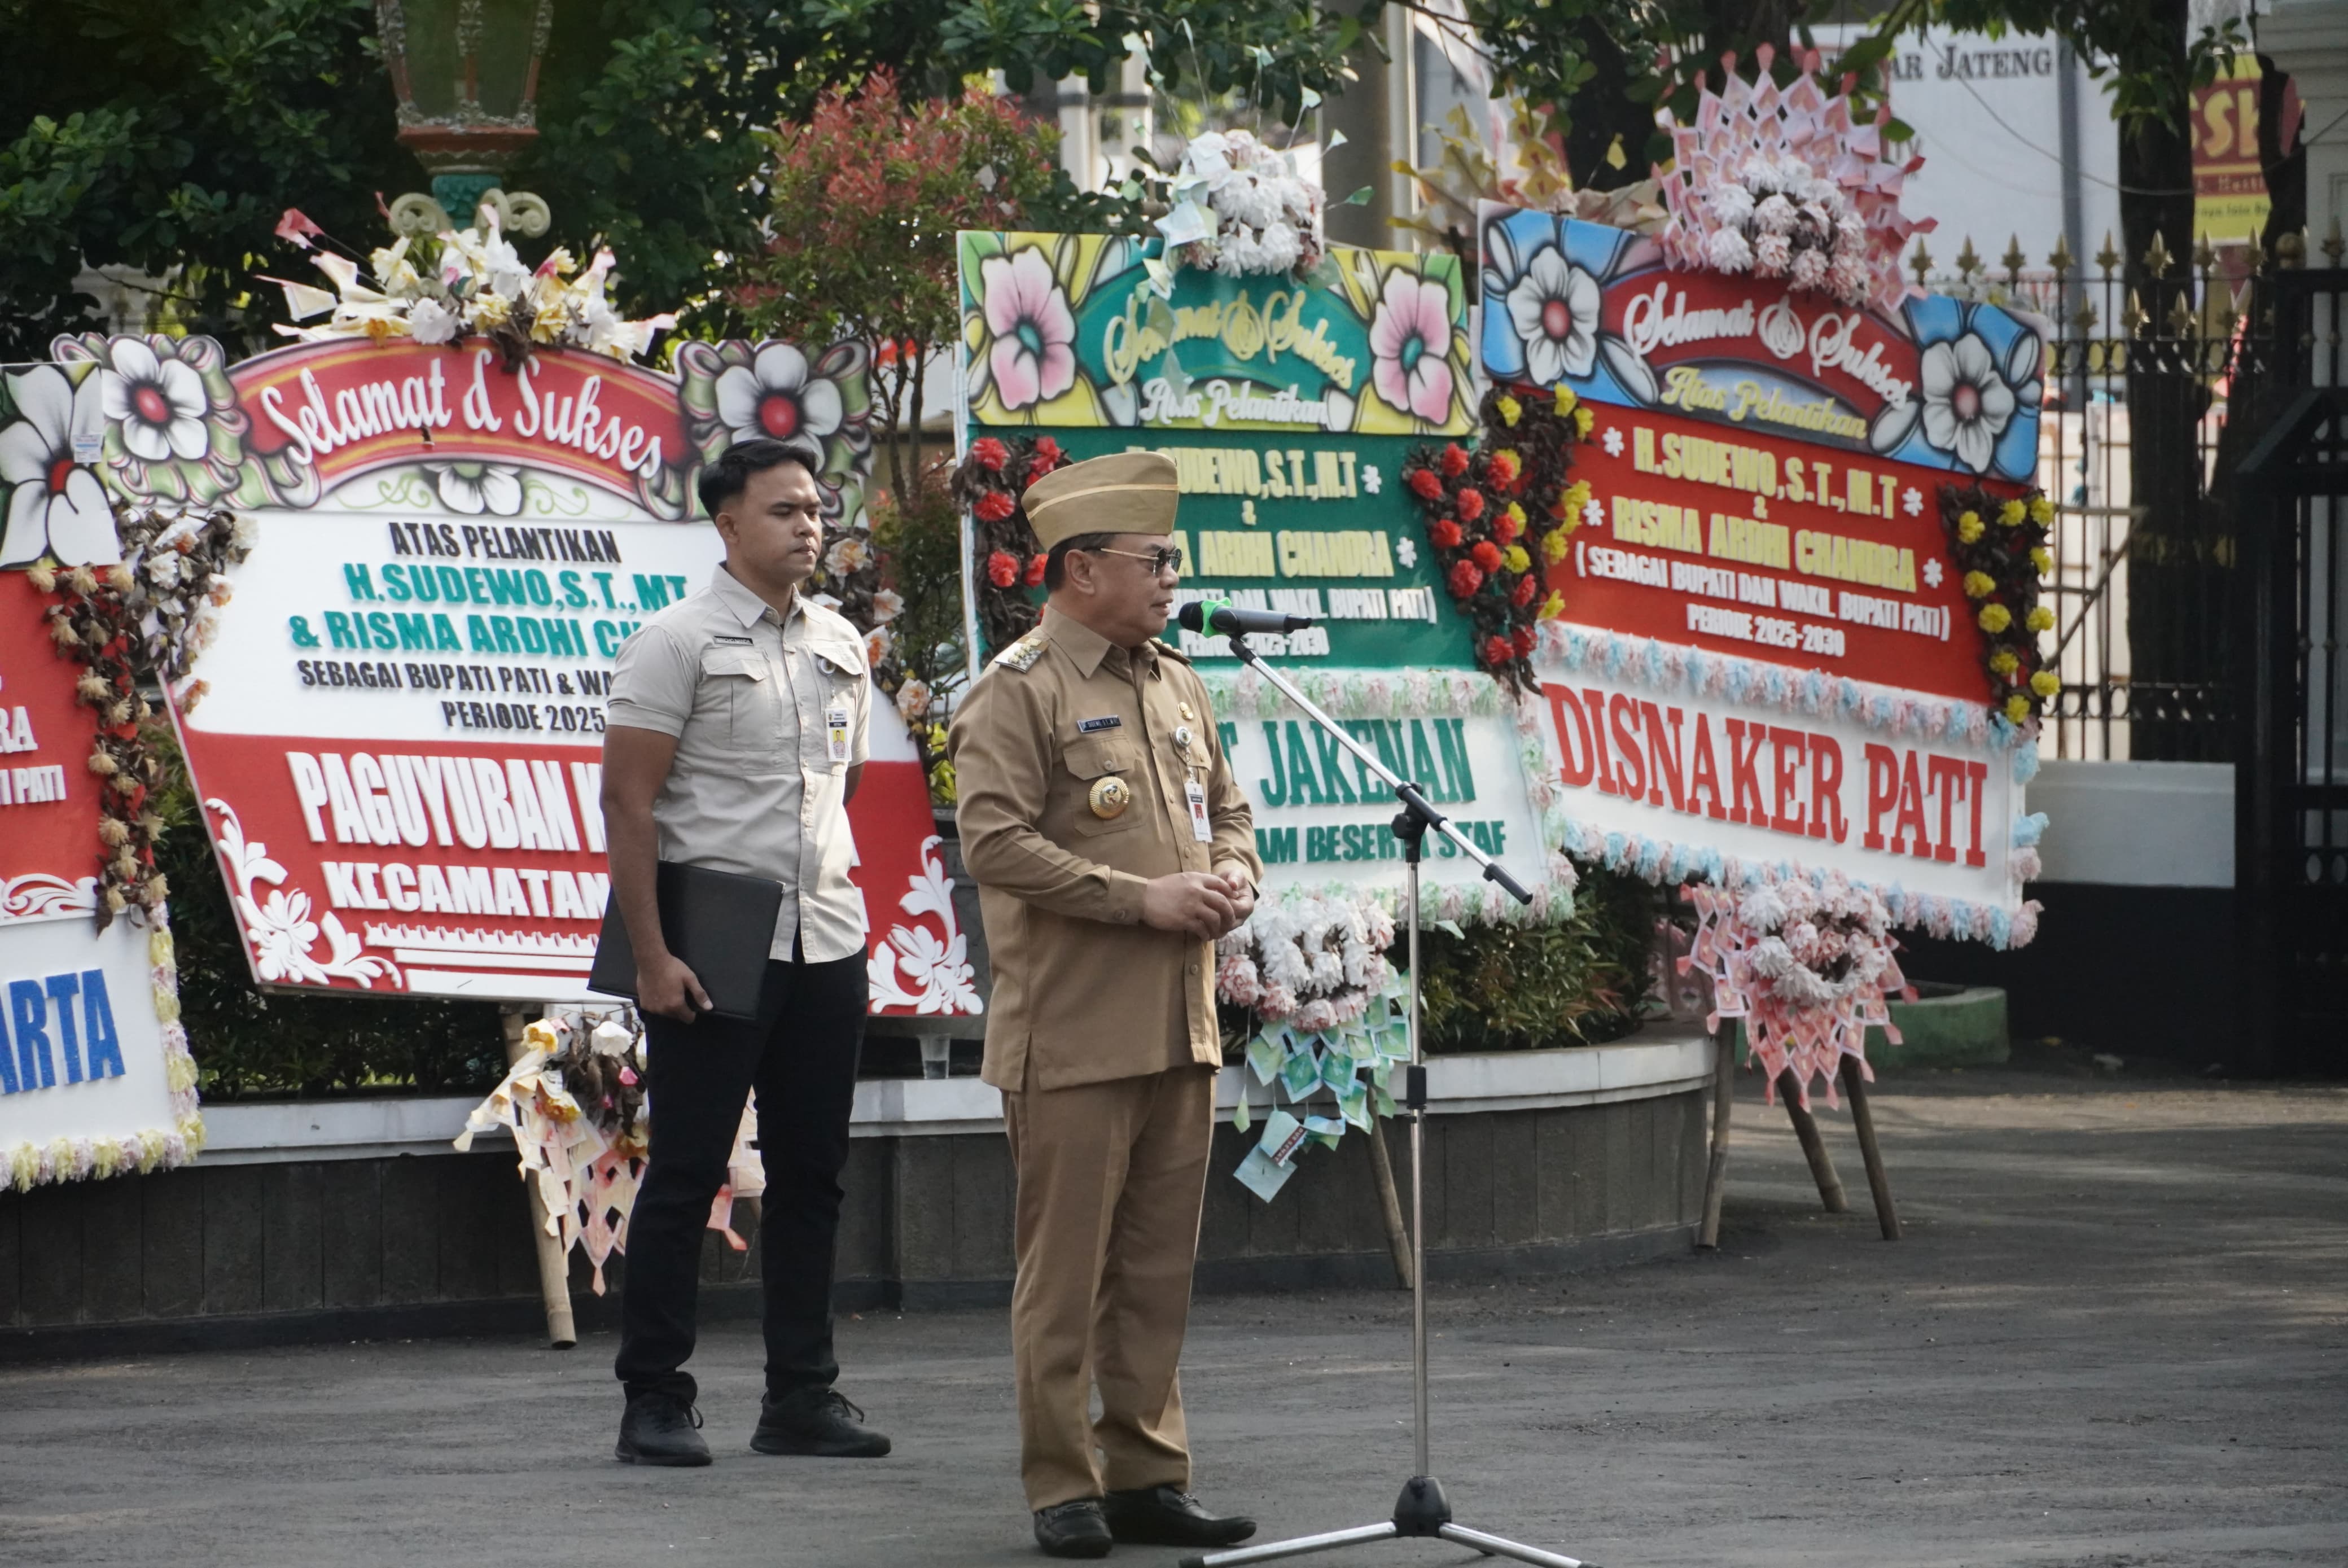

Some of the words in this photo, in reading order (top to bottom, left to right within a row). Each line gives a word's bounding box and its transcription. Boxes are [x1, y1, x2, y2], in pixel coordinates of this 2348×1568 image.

[1937, 43, 2052, 80] JATENG
[260, 357, 452, 466] Selamat
[514, 356, 660, 479] Sukses
[1752, 496, 1769, 520] &
[388, 522, 462, 558] ATAS
[462, 525, 623, 563] PELANTIKAN
[1198, 531, 1276, 577] ARDHI
[1275, 529, 1395, 579] CHANDRA
[1611, 495, 1703, 554] RISMA
[1707, 513, 1791, 570] ARDHI
[1794, 528, 1917, 593] CHANDRA
[1327, 588, 1388, 619] BUPATI
[1588, 545, 1668, 588] SEBAGAI
[1671, 560, 1736, 600] BUPATI
[1738, 576, 1776, 607] DAN
[1778, 579, 1836, 619] WAKIL
[1838, 590, 1900, 630] BUPATI
[288, 615, 323, 649] &
[323, 610, 463, 652] RISMA
[466, 612, 589, 658] ARDHI
[1686, 603, 1753, 640] PERIODE
[1754, 615, 1845, 658] 2025-2030
[296, 659, 403, 690] SEBAGAI
[405, 662, 497, 693] BUPATI
[497, 665, 553, 695] PATI
[556, 672, 576, 695] &
[440, 700, 543, 731] PERIODE
[12, 765, 67, 804] PATI
[1260, 717, 1477, 807] JAKENAN
[1540, 682, 1848, 844] DISNAKER
[1863, 742, 1988, 868] PATI
[285, 751, 581, 852] PAGUYUBAN
[320, 861, 612, 919] KECAMATAN
